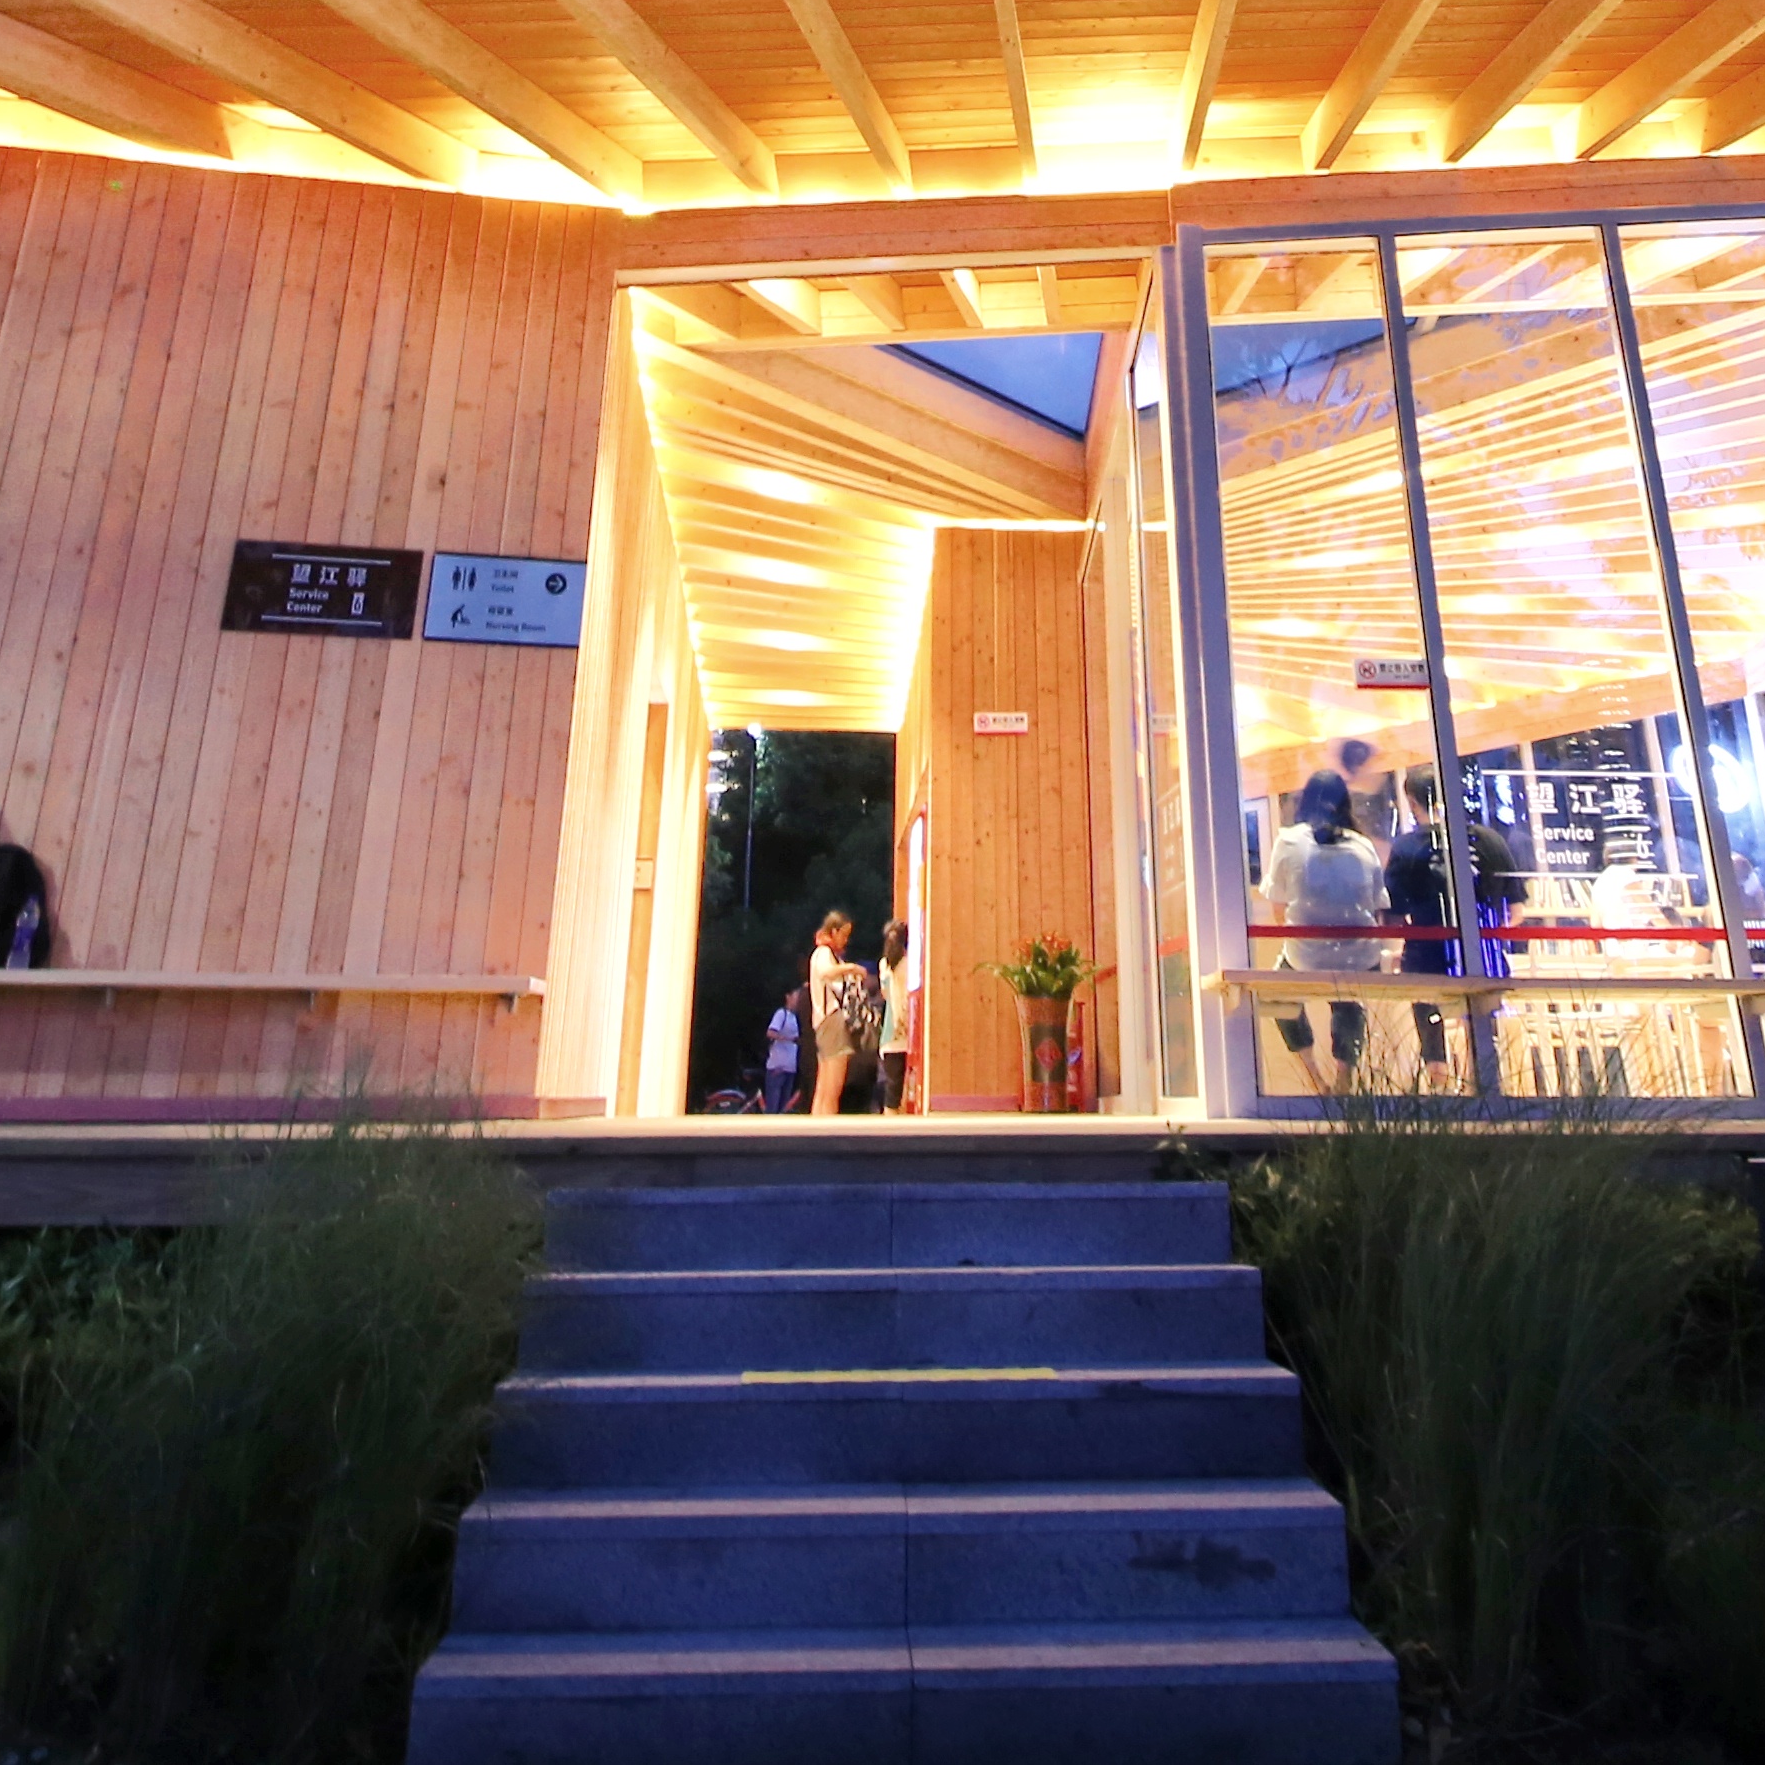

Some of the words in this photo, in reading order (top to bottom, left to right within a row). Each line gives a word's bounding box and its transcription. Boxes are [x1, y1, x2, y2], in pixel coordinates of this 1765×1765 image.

[289, 587, 329, 601] Service
[287, 601, 323, 613] Center
[1533, 823, 1595, 842] Service
[1536, 847, 1590, 865] Center
